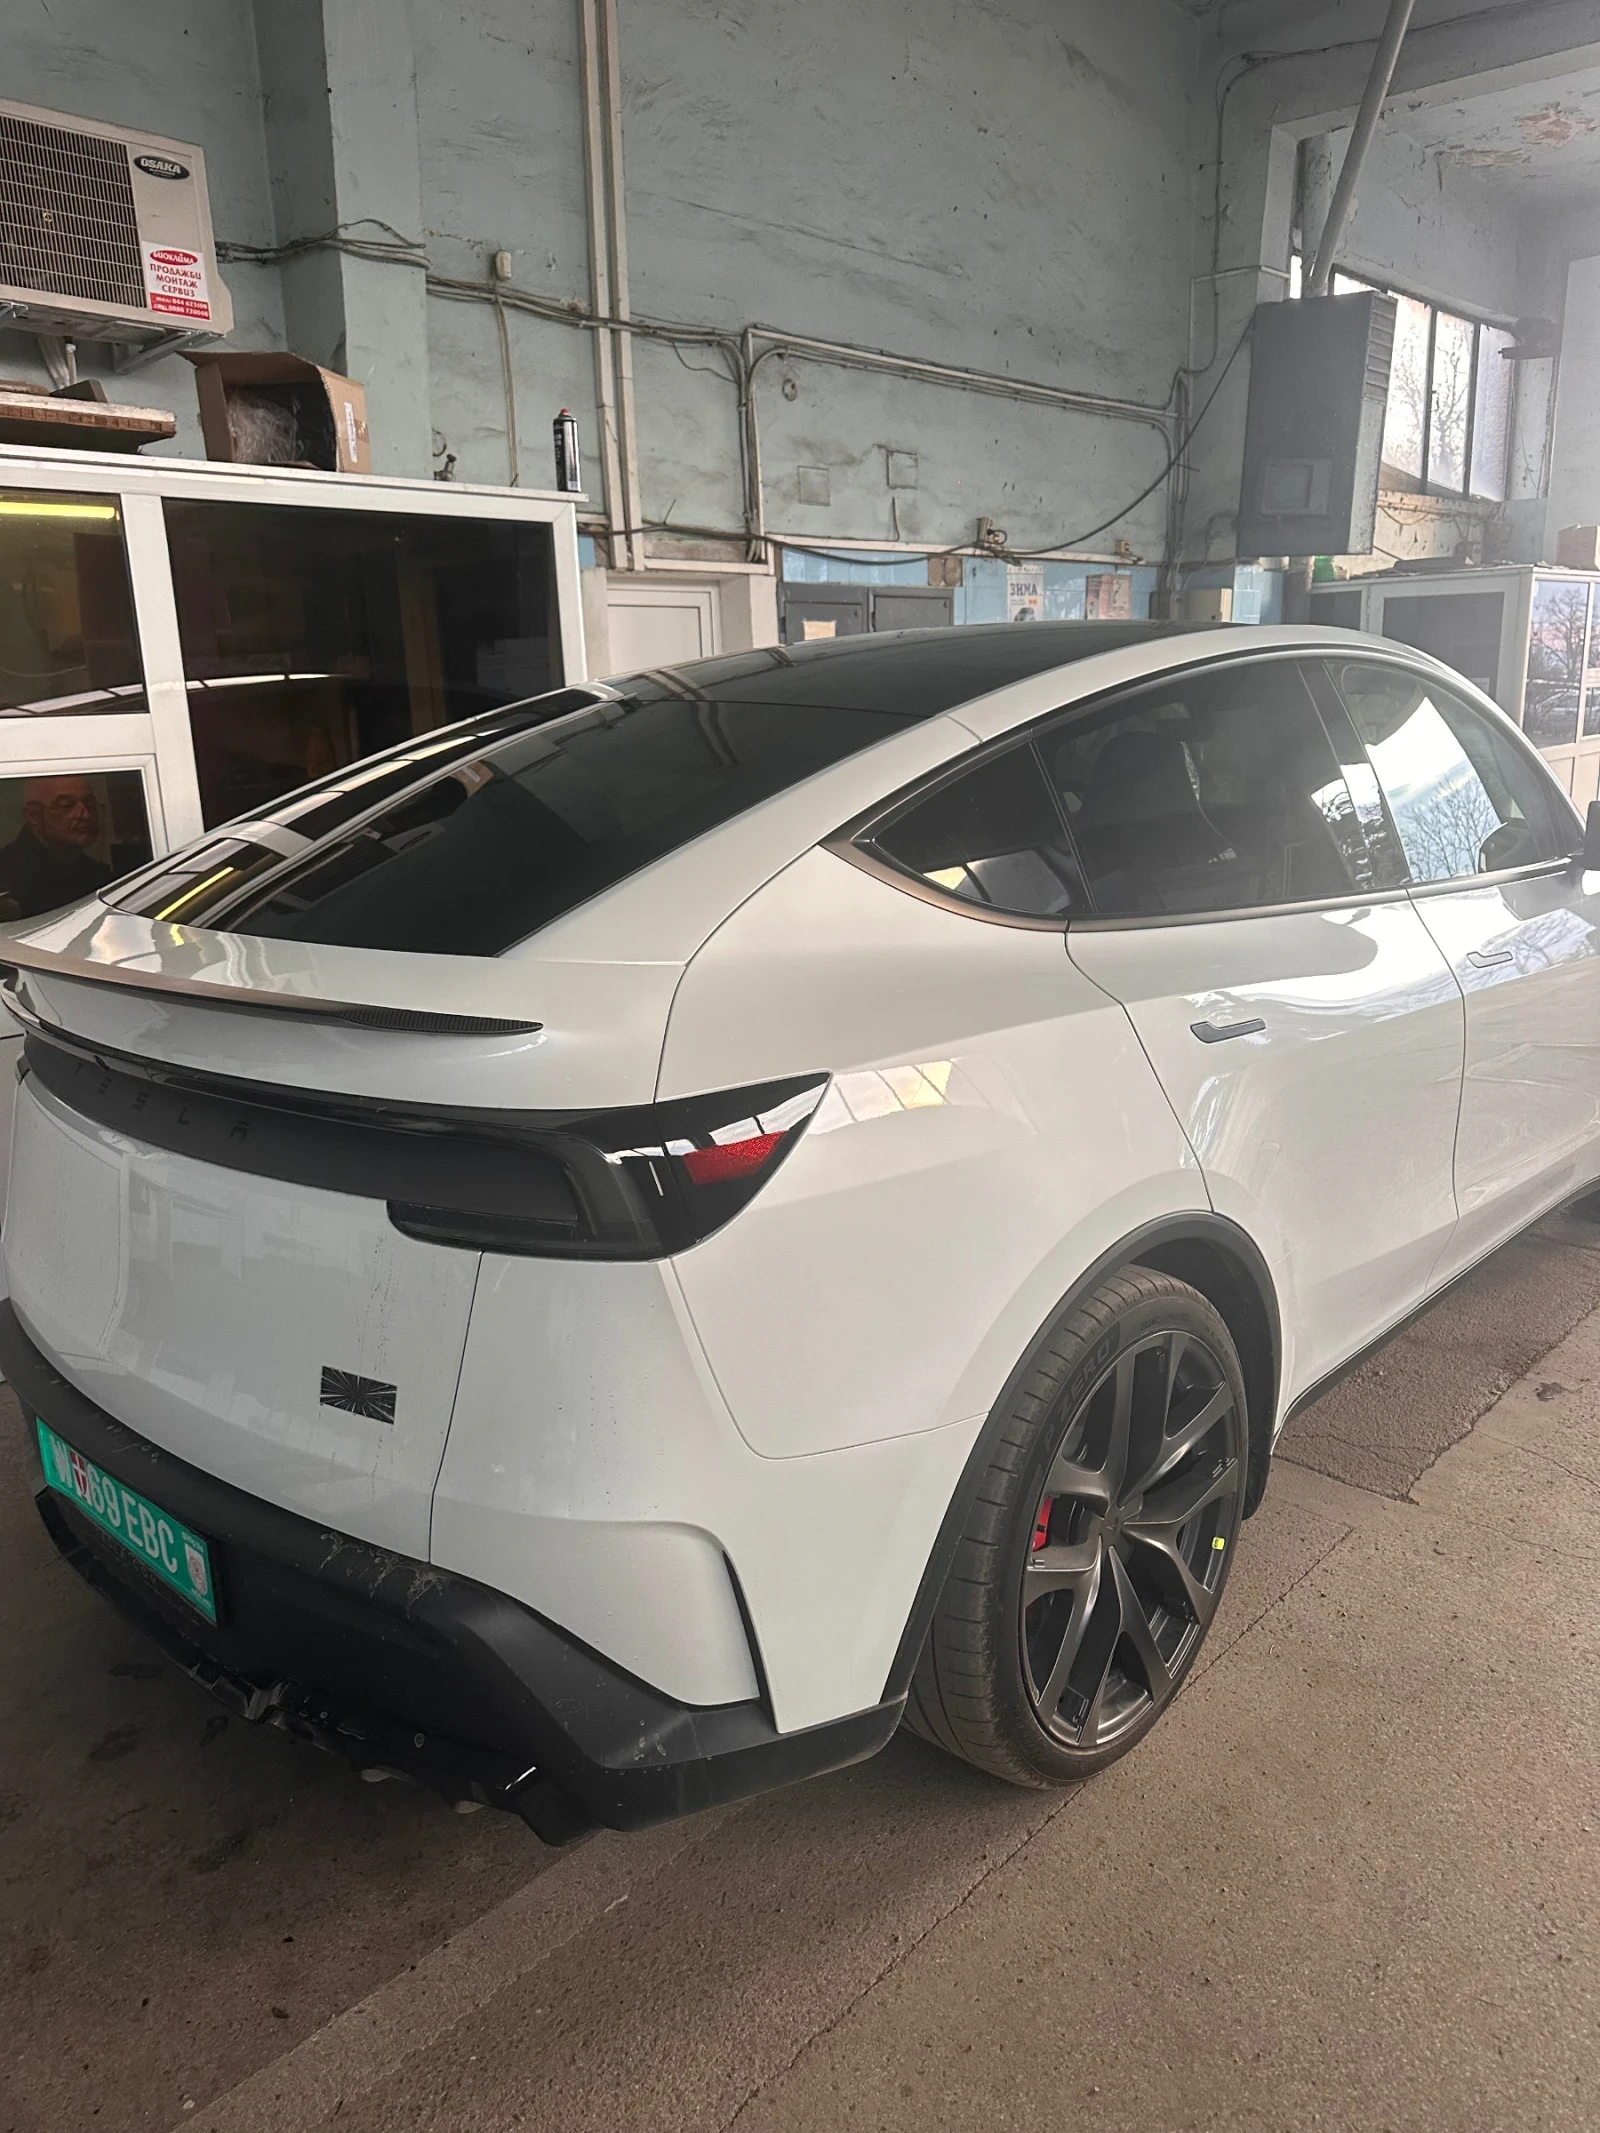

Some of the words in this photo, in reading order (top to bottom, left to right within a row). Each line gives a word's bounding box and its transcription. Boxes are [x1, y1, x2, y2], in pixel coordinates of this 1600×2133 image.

[140, 157, 181, 174] OSAKA
[150, 263, 201, 280] ПРОДАЖБИ
[156, 274, 198, 288] МОНТАЖ
[162, 285, 195, 297] СЕРВИЗ
[1010, 583, 1037, 596] ЗИМА
[72, 1062, 252, 1141] TESLA
